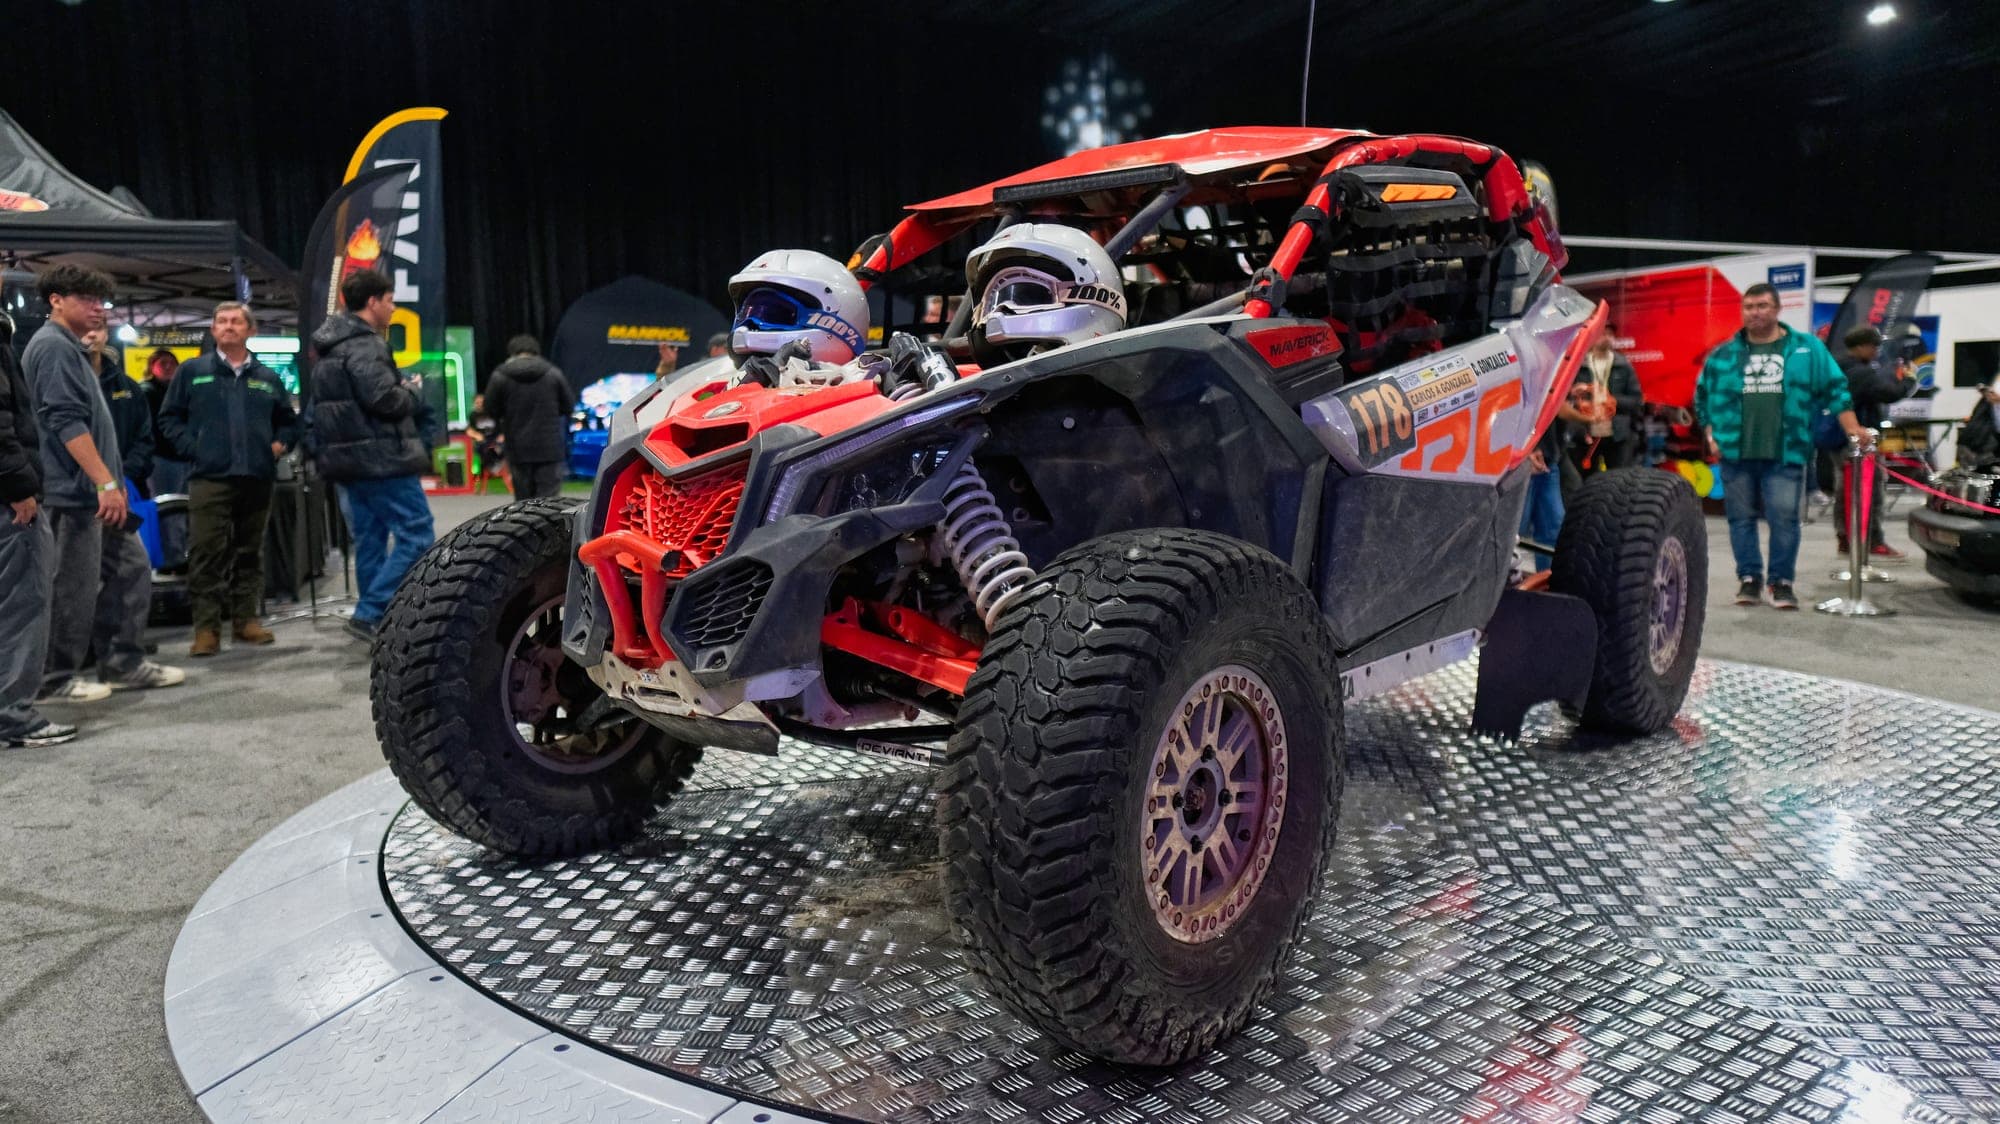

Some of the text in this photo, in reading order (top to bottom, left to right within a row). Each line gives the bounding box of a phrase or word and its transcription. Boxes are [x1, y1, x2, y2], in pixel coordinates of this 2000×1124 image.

[1067, 285, 1120, 310] 100%
[806, 312, 859, 346] 100%
[1269, 331, 1329, 356] MAVERICK
[1477, 350, 1510, 374] GONZALEZ
[1410, 388, 1436, 406] CARLOS
[1441, 373, 1473, 393] GONZALEZ
[1351, 383, 1412, 455] 178
[861, 742, 928, 762] DEVIANT
